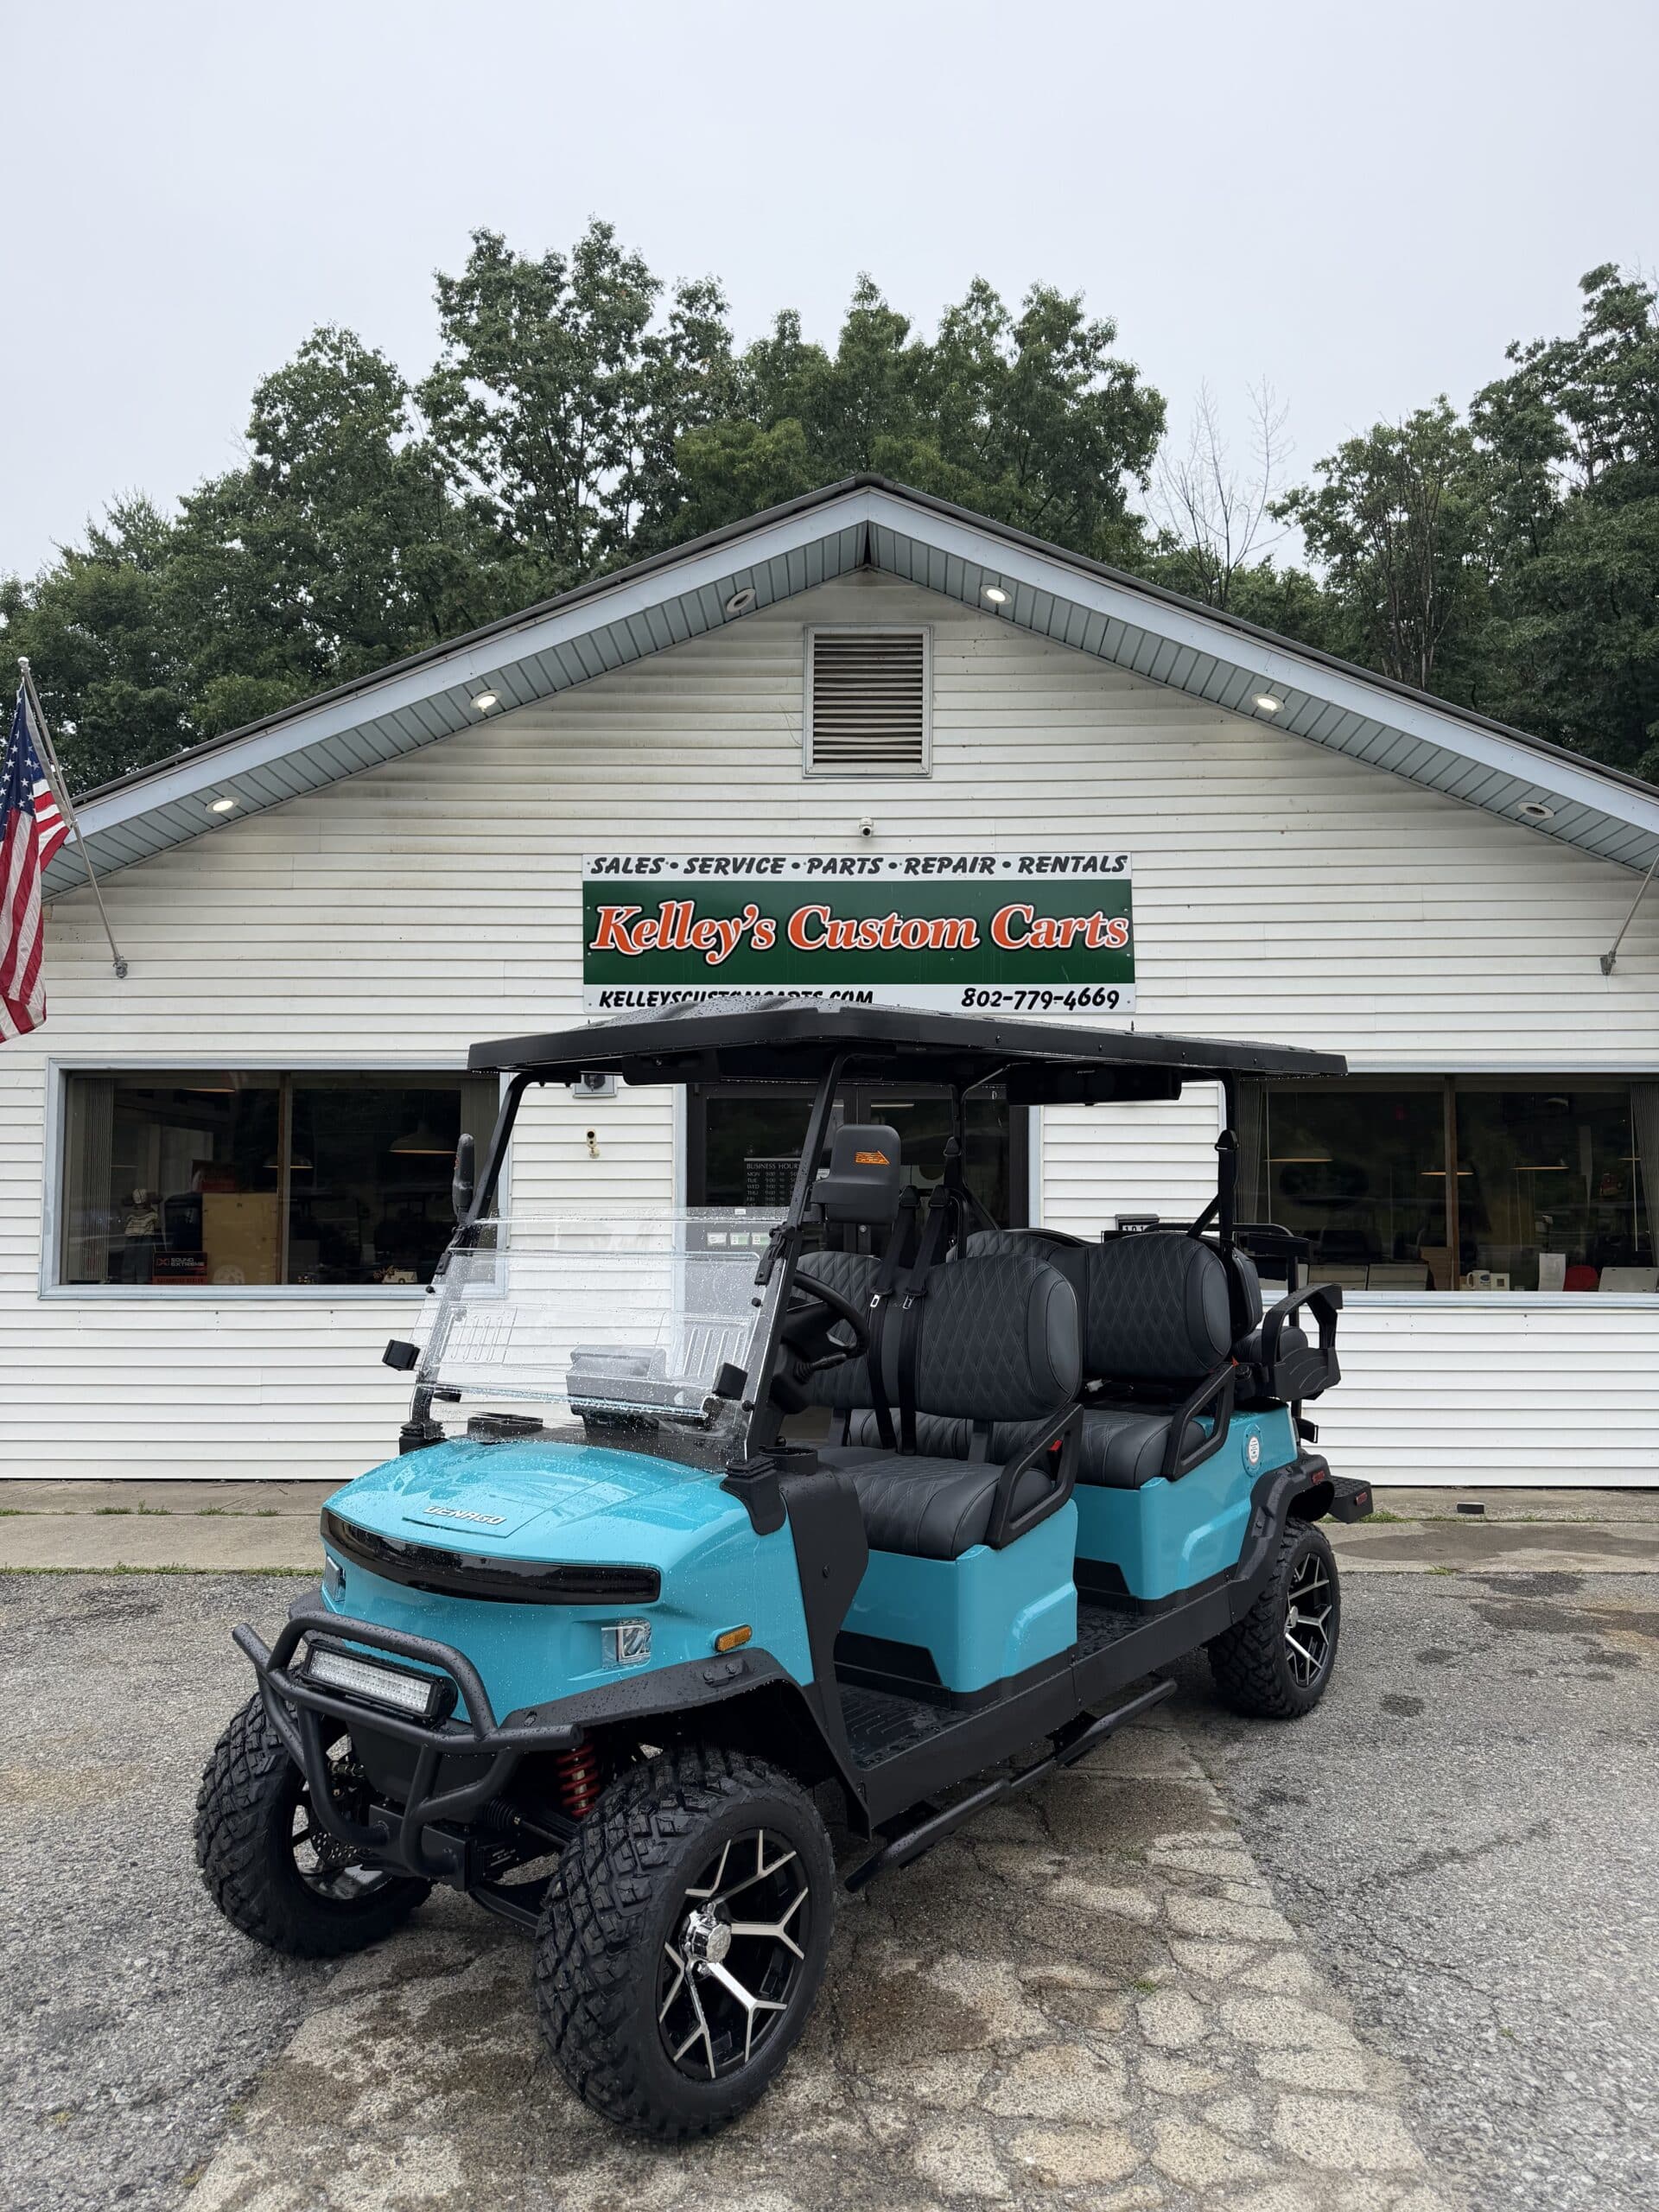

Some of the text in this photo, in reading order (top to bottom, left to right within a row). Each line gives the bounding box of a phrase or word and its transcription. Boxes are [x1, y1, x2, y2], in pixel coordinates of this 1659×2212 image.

[591, 855, 1128, 875] SALES SERVICE PARTS REPAIR RENTALS
[589, 899, 1128, 965] Kelley's Custom Carts
[598, 990, 874, 1008] KELLEYSCUSTCOM
[961, 987, 1120, 1011] 802-779-4669
[423, 1506, 507, 1525] DENAGO
